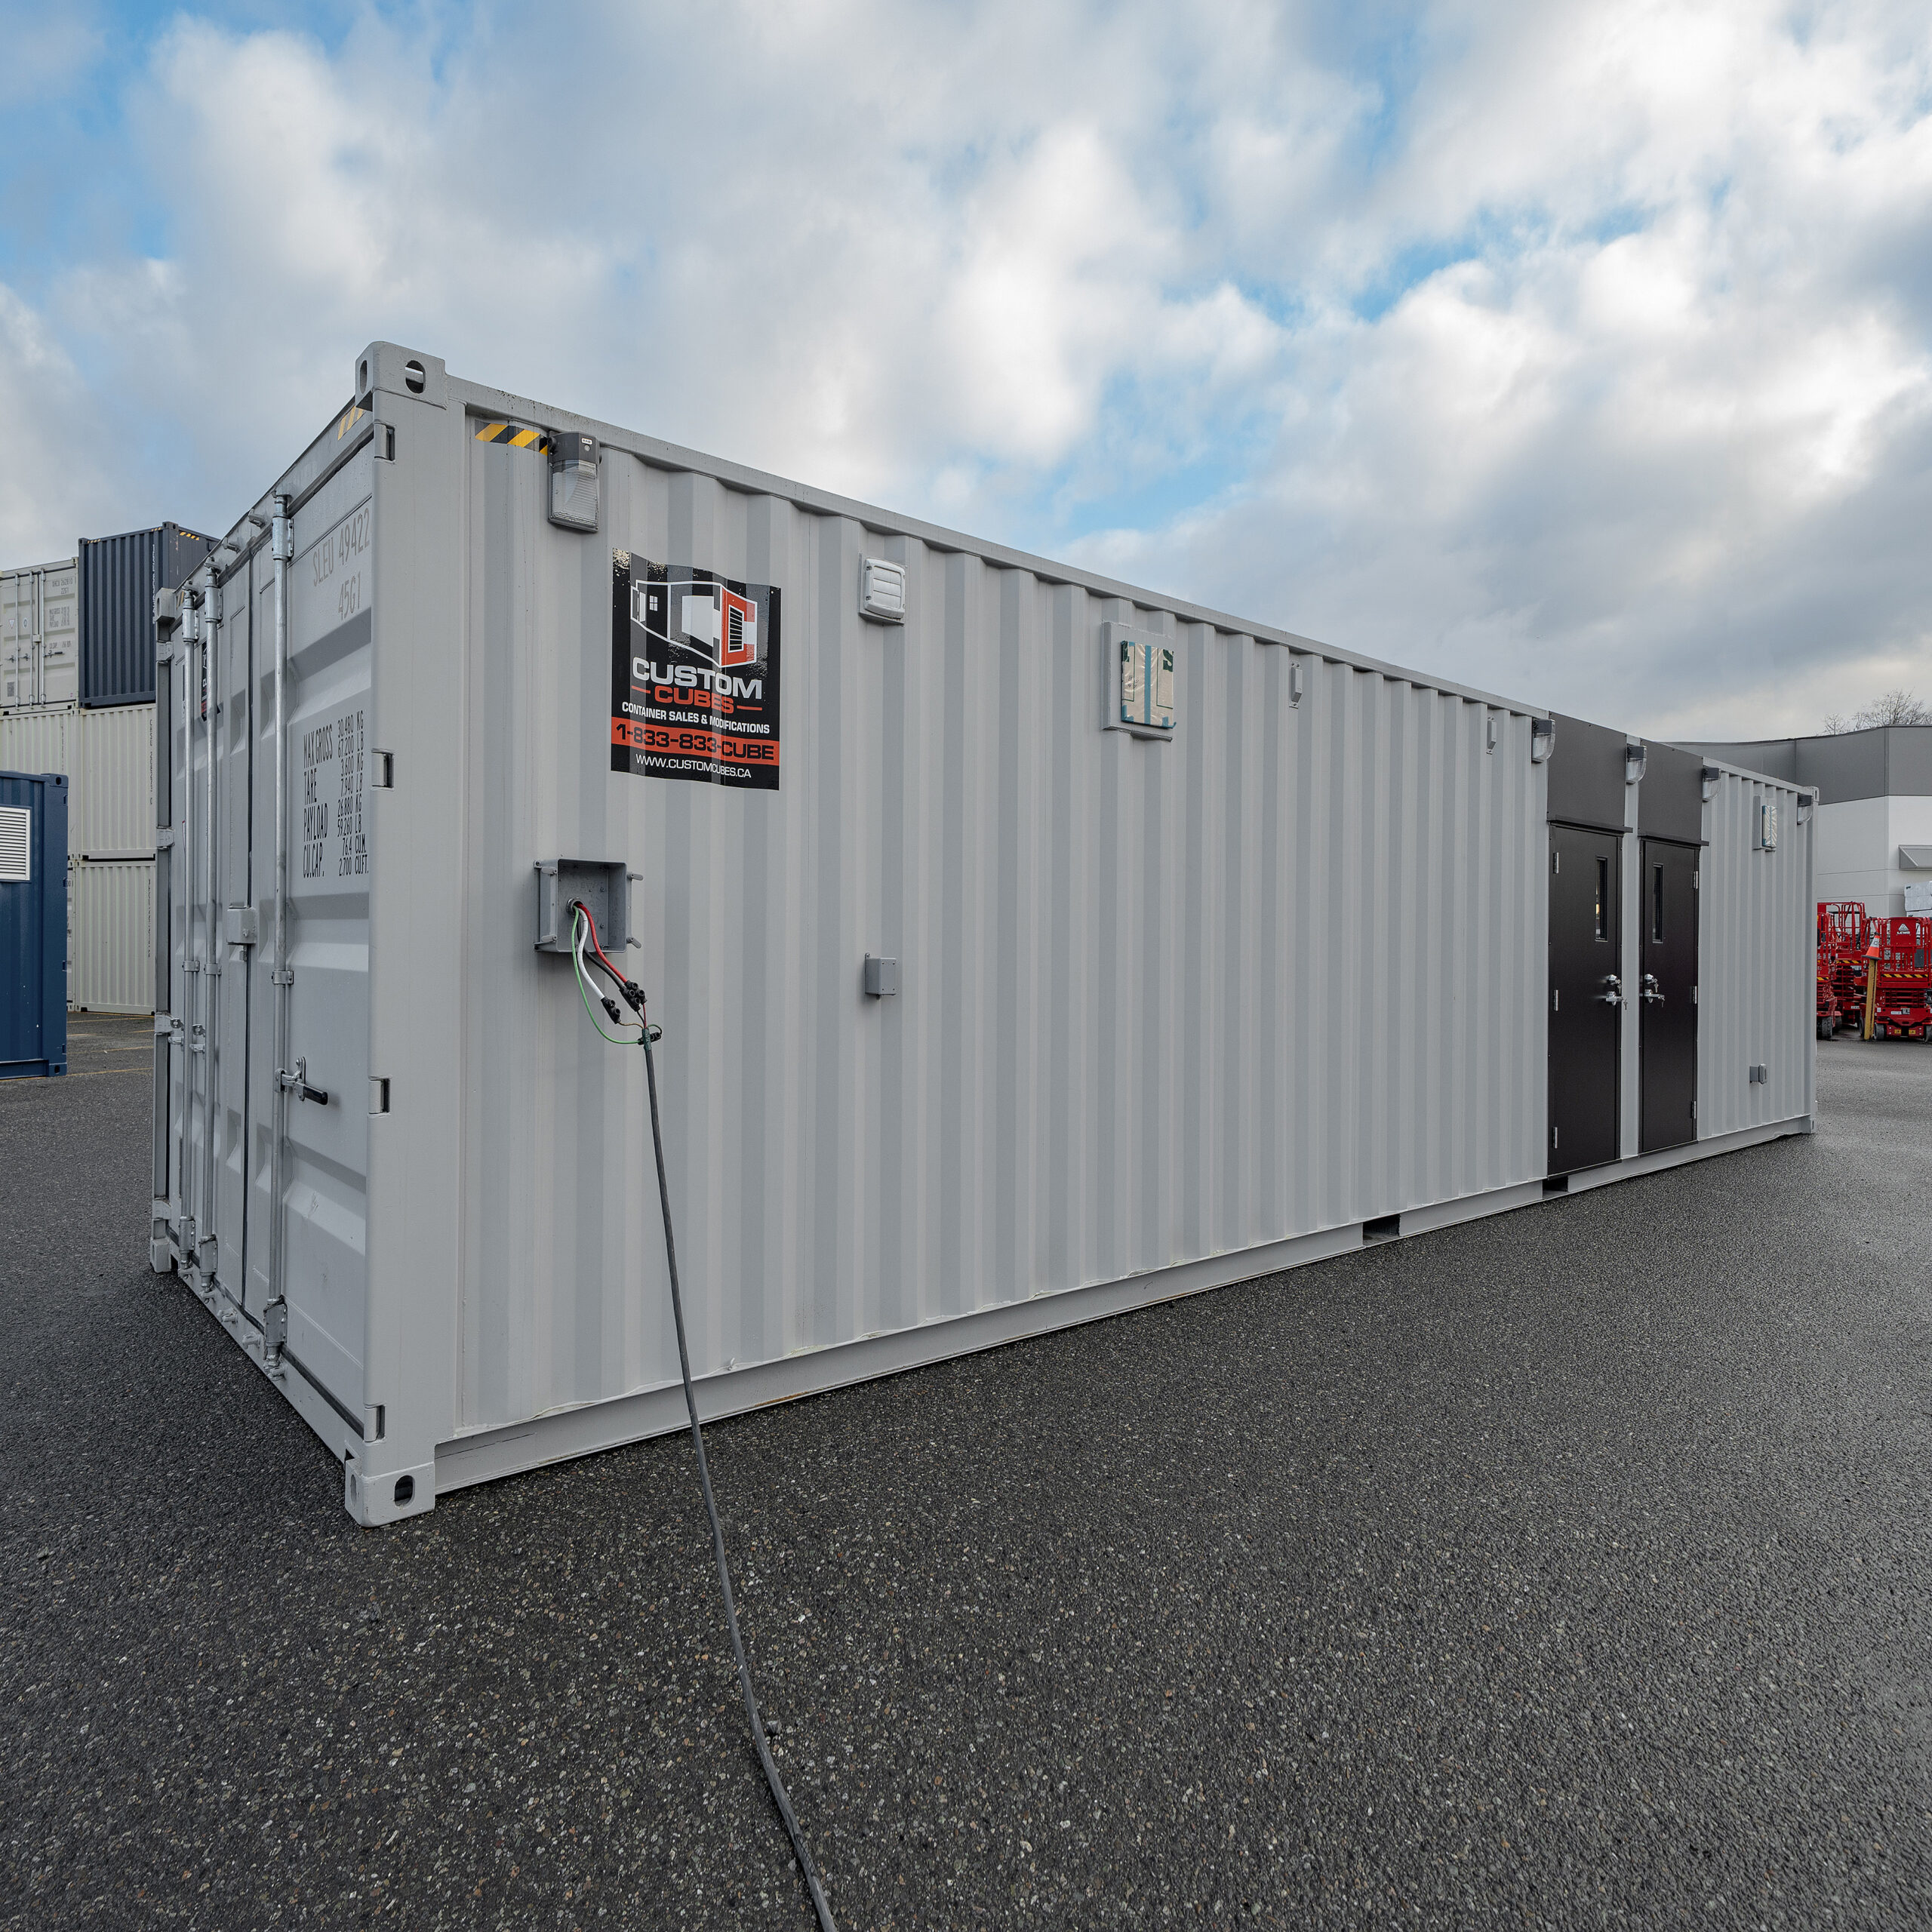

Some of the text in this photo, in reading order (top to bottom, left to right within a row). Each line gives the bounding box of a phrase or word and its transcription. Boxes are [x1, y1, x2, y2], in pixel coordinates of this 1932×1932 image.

[313, 537, 334, 587] SLEU
[338, 571, 361, 620] 45G1
[632, 657, 762, 700] CUSTOM
[622, 701, 770, 734] CONTAINER SALES & MODIFICATIONS
[654, 685, 734, 714] CUBES
[303, 730, 315, 769] MAX
[315, 723, 333, 764] GROSS
[356, 709, 364, 731] KG
[357, 731, 364, 752] LB
[616, 723, 775, 761] 1-833-833-CUBE
[303, 768, 317, 805] TARE
[356, 752, 364, 772] KG
[356, 772, 363, 792] LB
[635, 753, 752, 778] WWW.CUSTOMCUBES.CA
[303, 802, 328, 842] PAYLOAD
[355, 792, 362, 813] KG
[355, 814, 361, 834] LB
